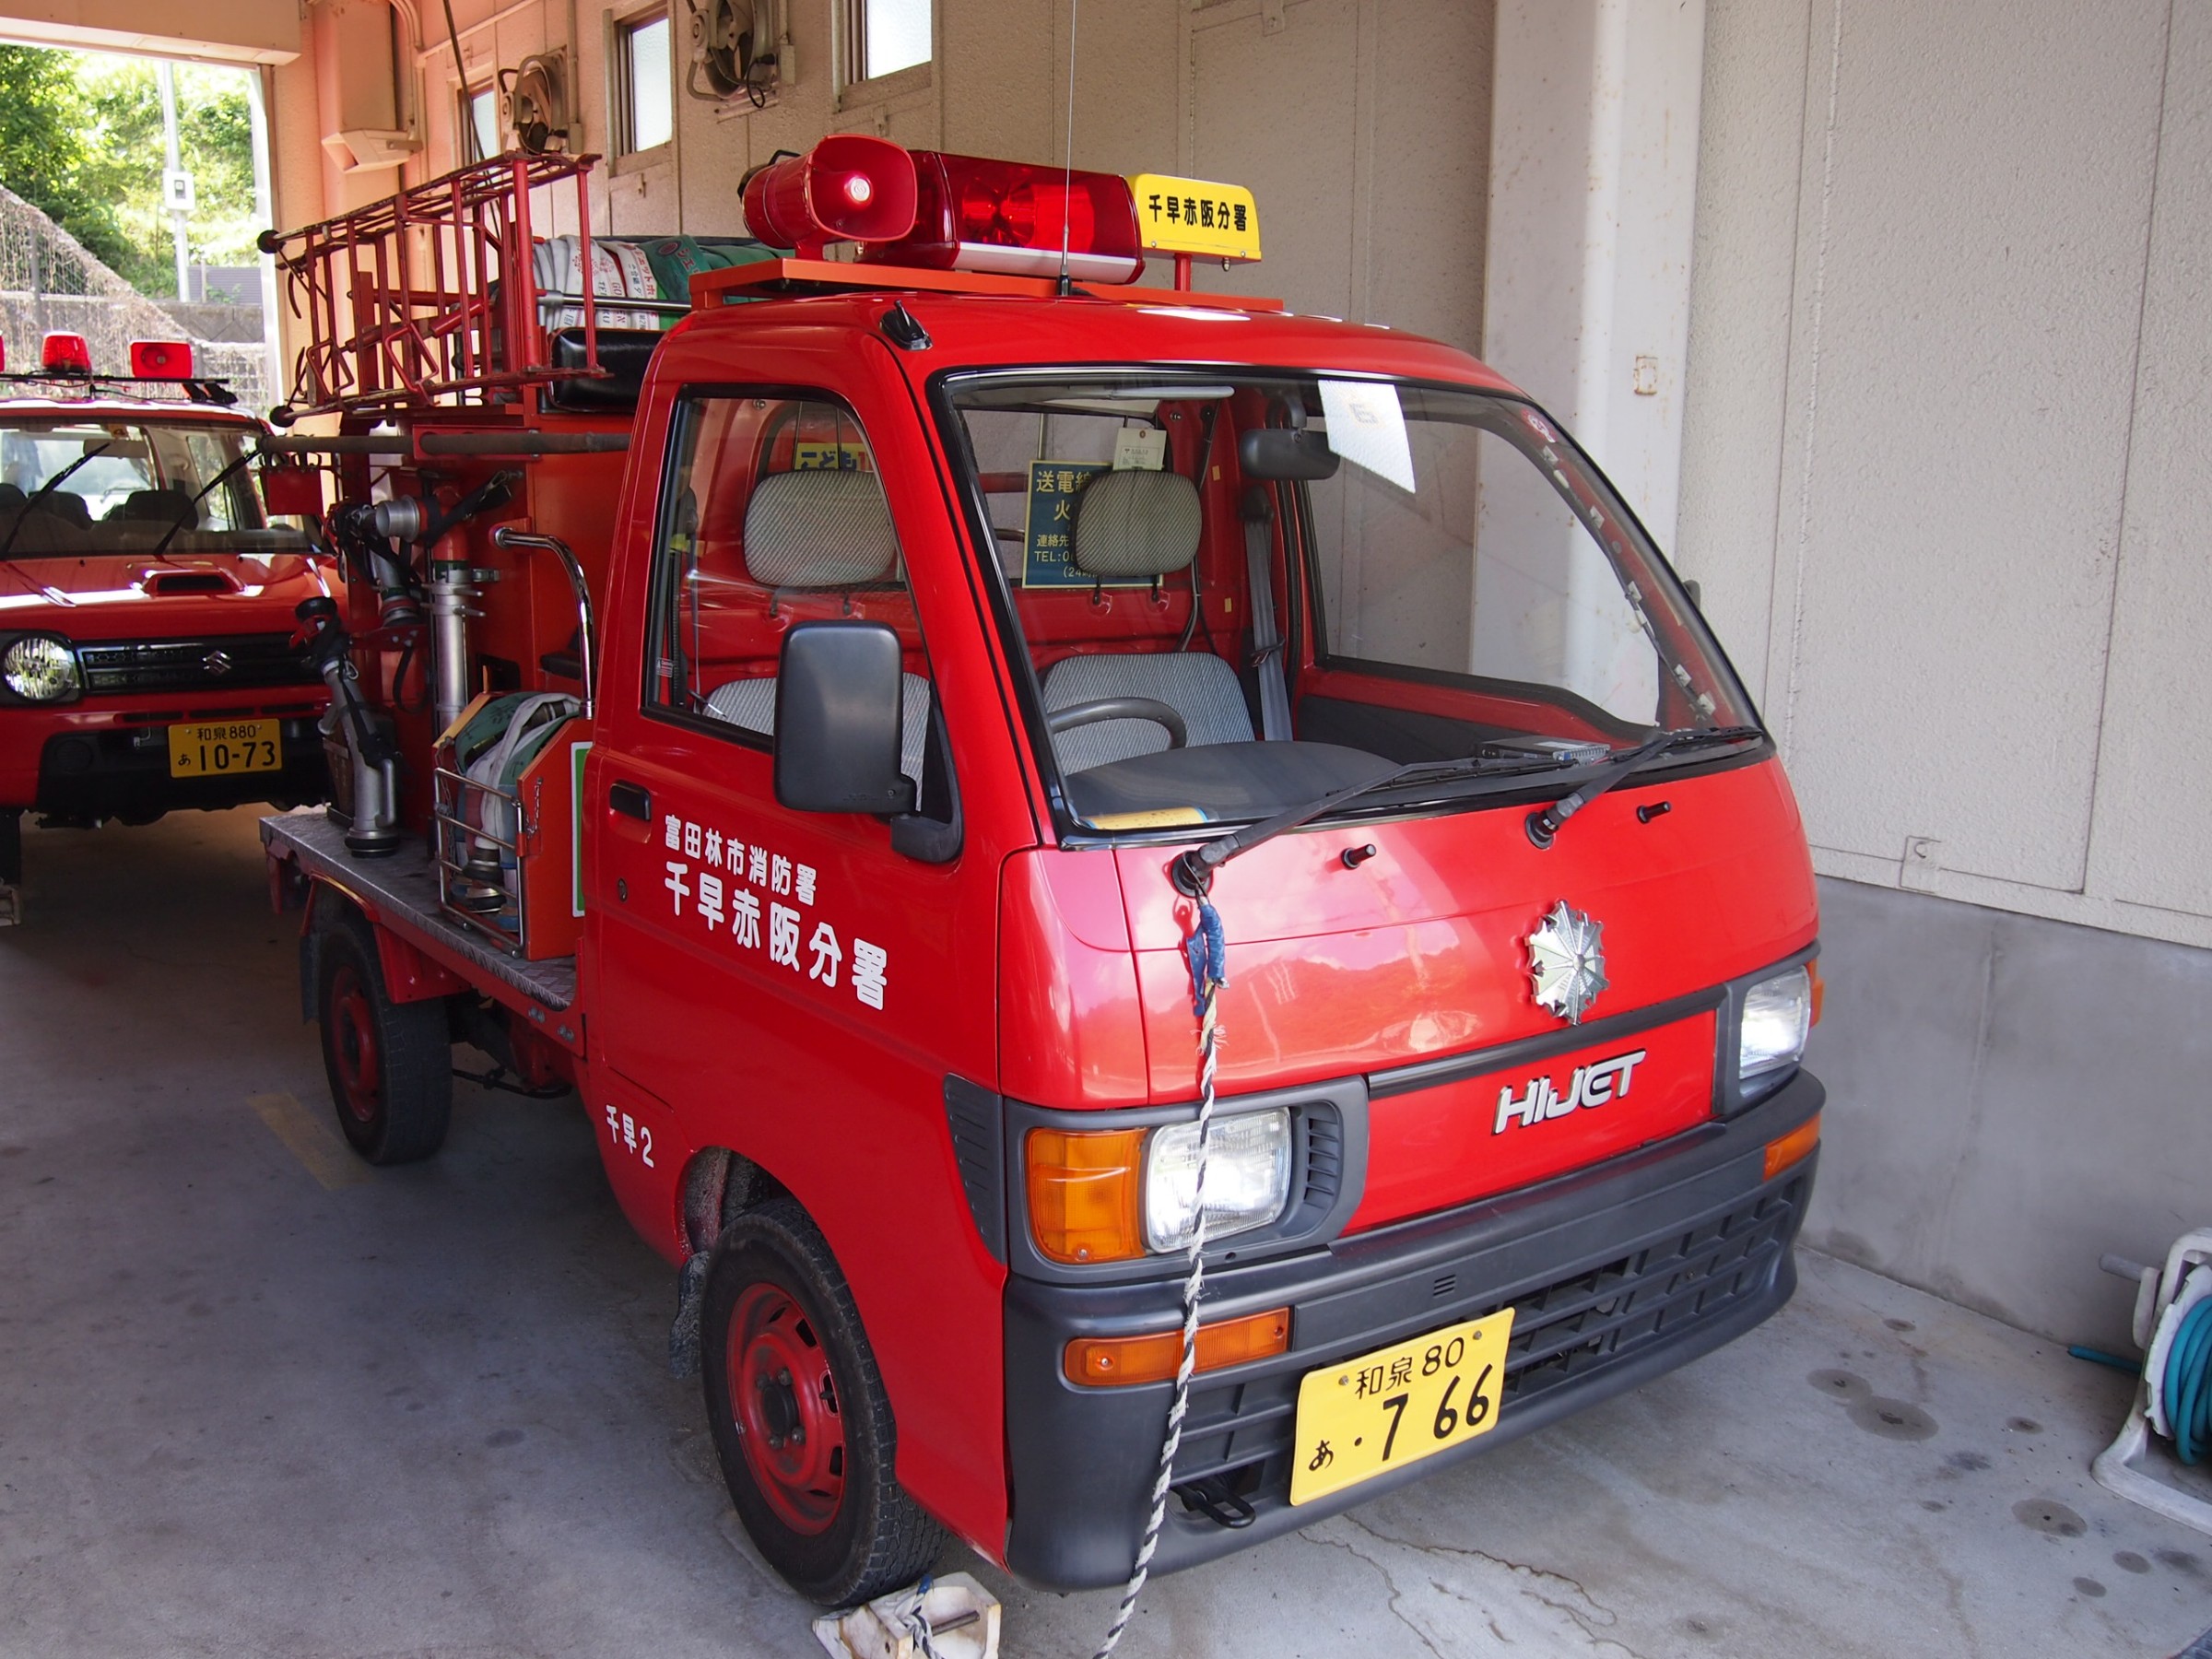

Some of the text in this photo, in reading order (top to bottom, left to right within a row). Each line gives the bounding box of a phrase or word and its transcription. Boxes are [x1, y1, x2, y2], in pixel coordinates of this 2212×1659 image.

[1148, 194, 1247, 231] 千早赤阪分署
[1036, 534, 1070, 548] 連絡先
[178, 740, 276, 771] あ 10-73
[665, 814, 817, 907] 富田林市消防署
[665, 861, 888, 1011] 千早赤阪分署
[1309, 1440, 1334, 1471] あ
